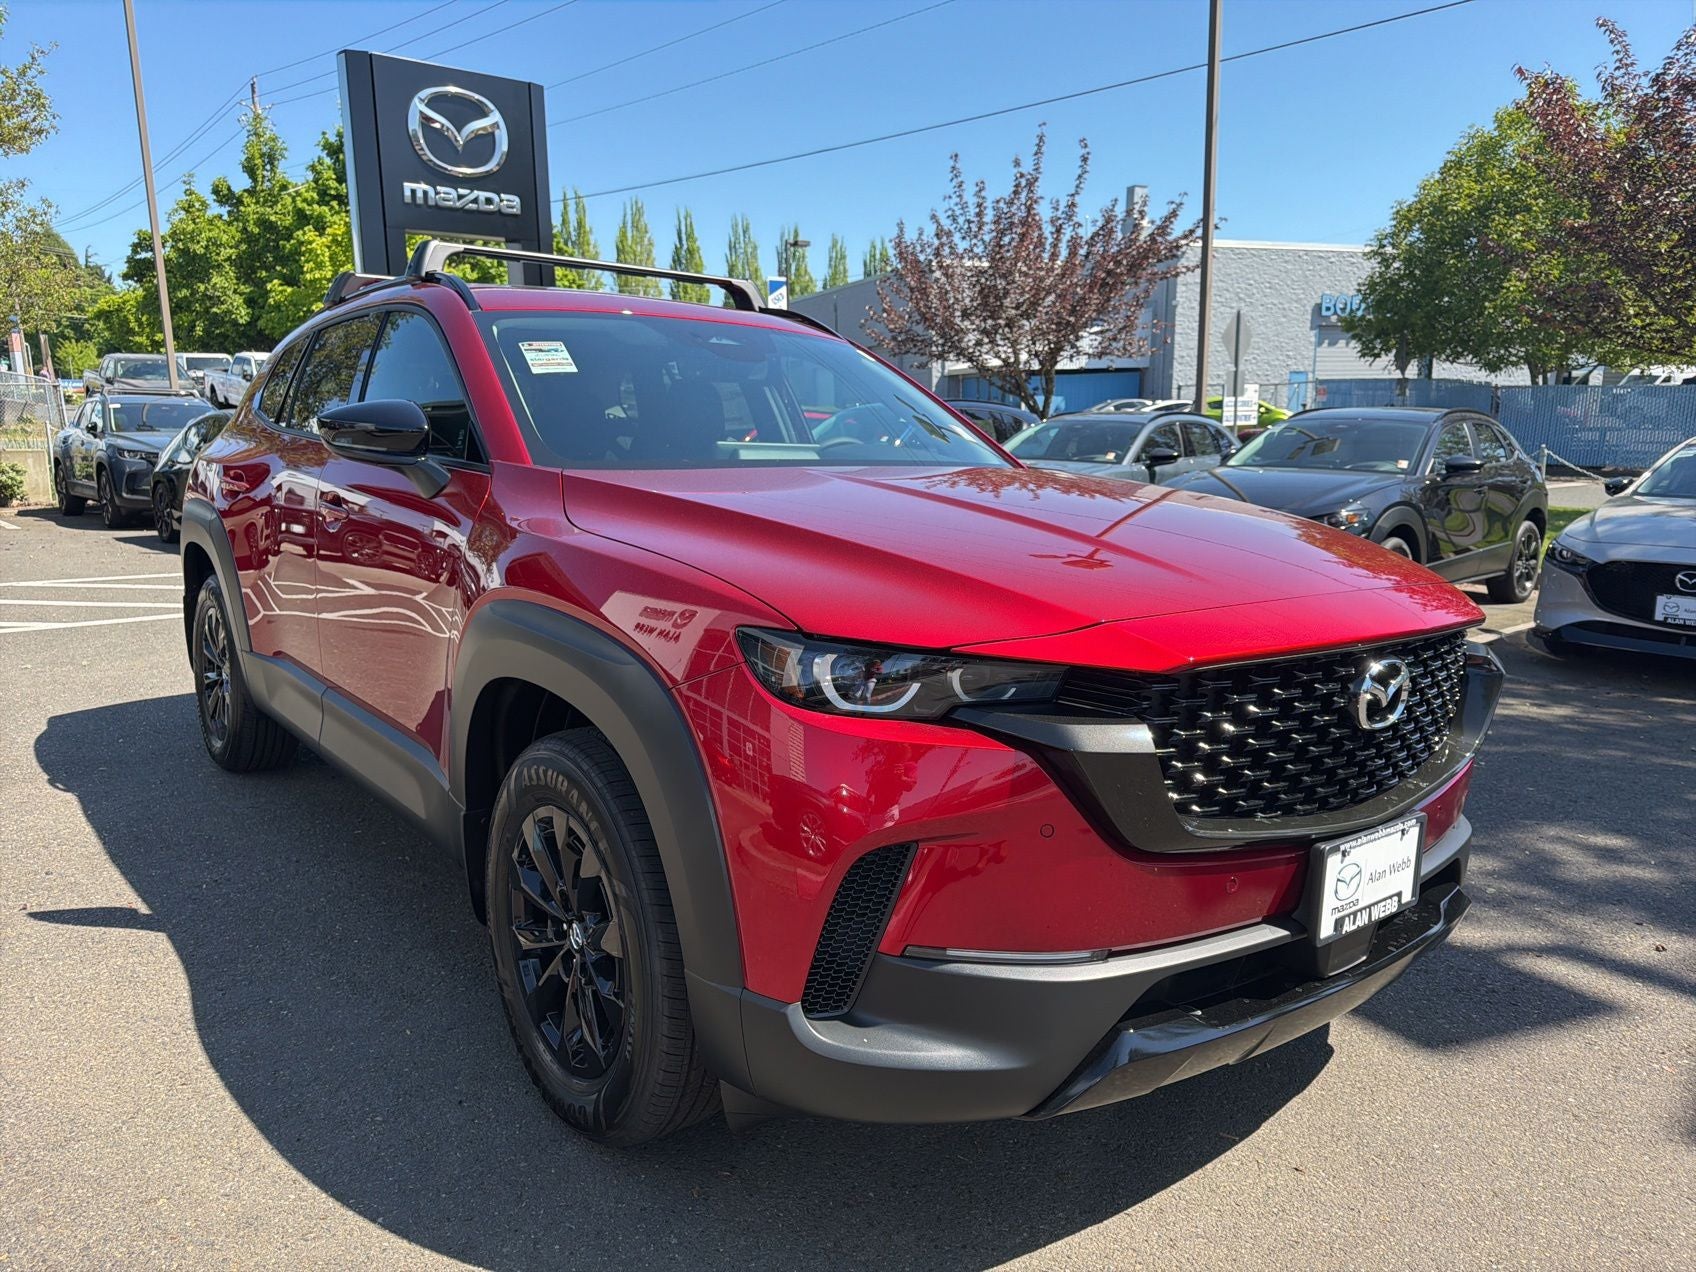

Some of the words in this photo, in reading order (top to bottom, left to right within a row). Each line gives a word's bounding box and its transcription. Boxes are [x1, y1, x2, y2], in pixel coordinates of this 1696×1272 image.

[1367, 868, 1387, 886] Alan
[1389, 856, 1411, 876] Webb
[1342, 907, 1370, 935] ALAN
[1371, 896, 1398, 921] WEBB
